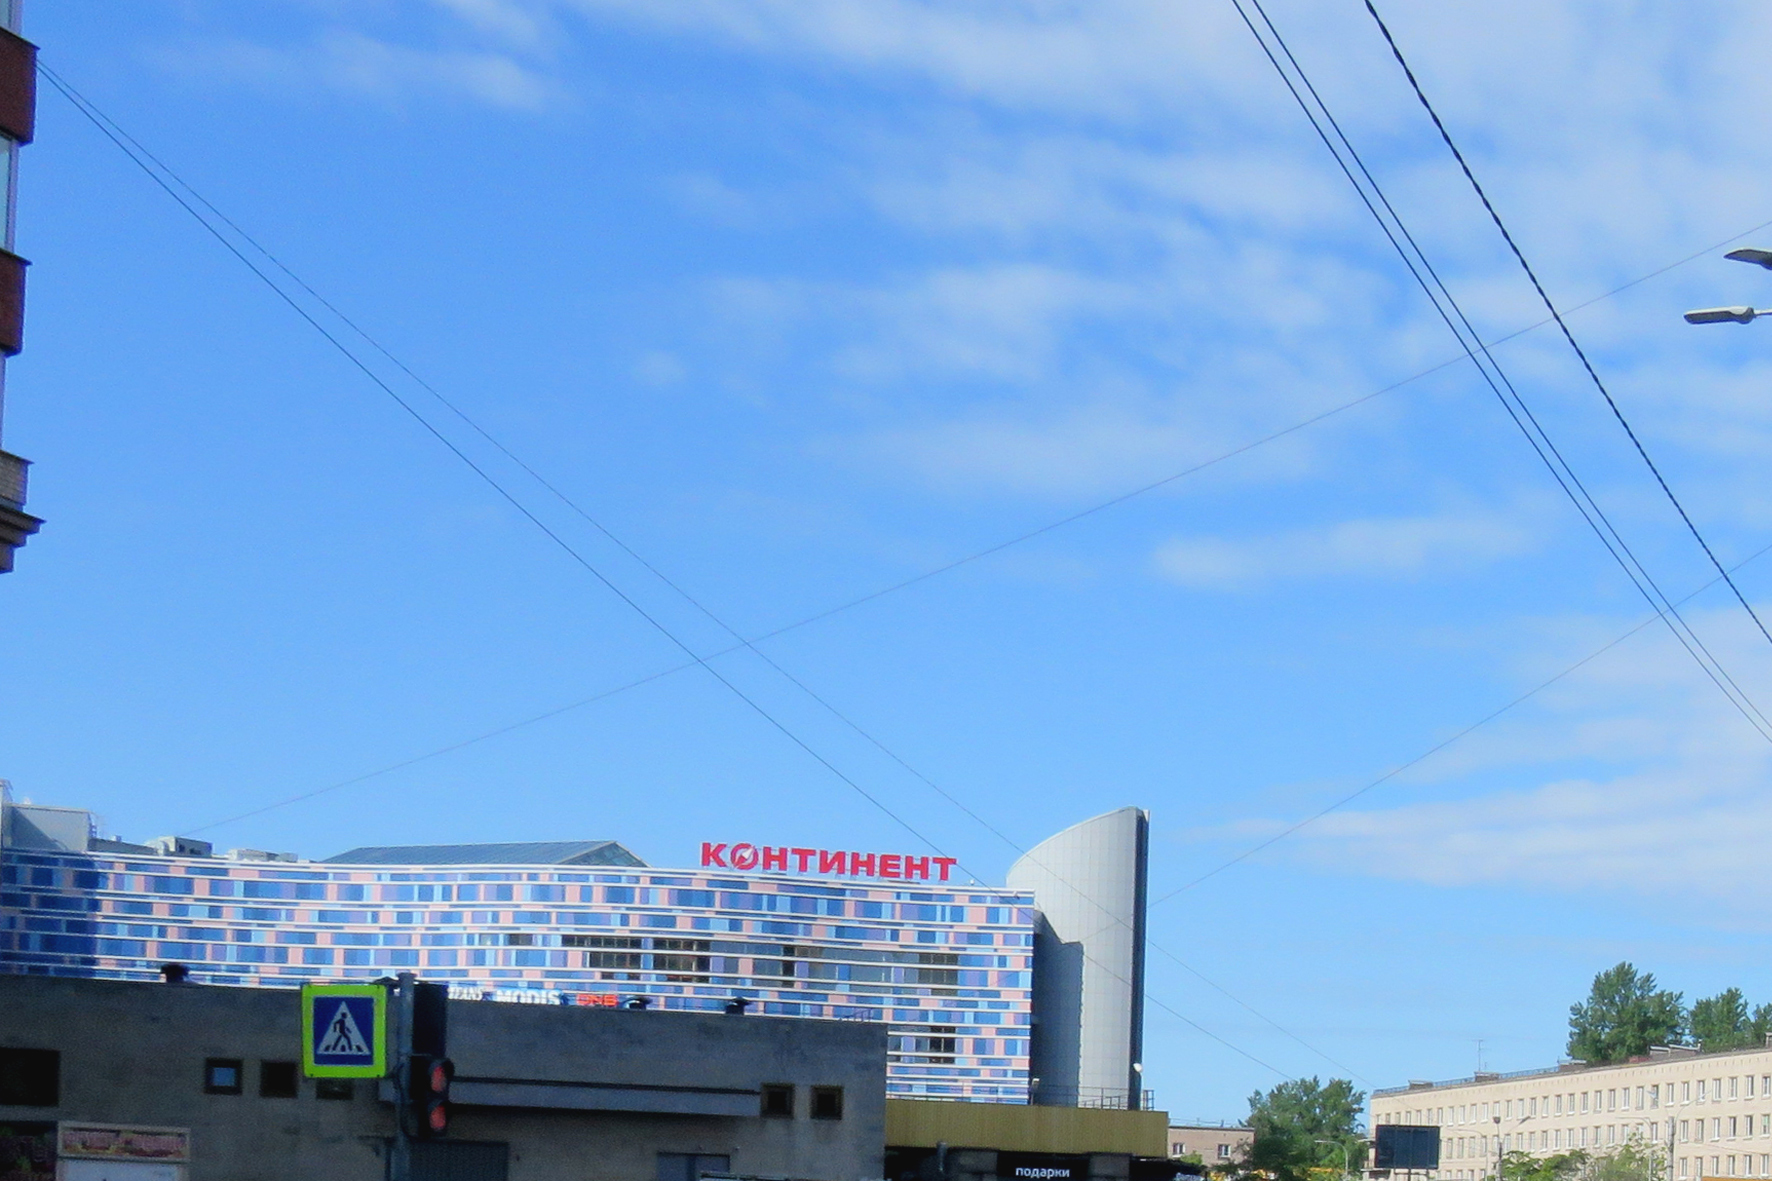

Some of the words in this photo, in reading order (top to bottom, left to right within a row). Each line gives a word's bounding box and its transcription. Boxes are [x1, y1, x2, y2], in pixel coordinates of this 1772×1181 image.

[701, 842, 957, 881] КОНТИНЕНТ
[496, 989, 561, 1005] MODIS
[1015, 1167, 1070, 1178] подарки
